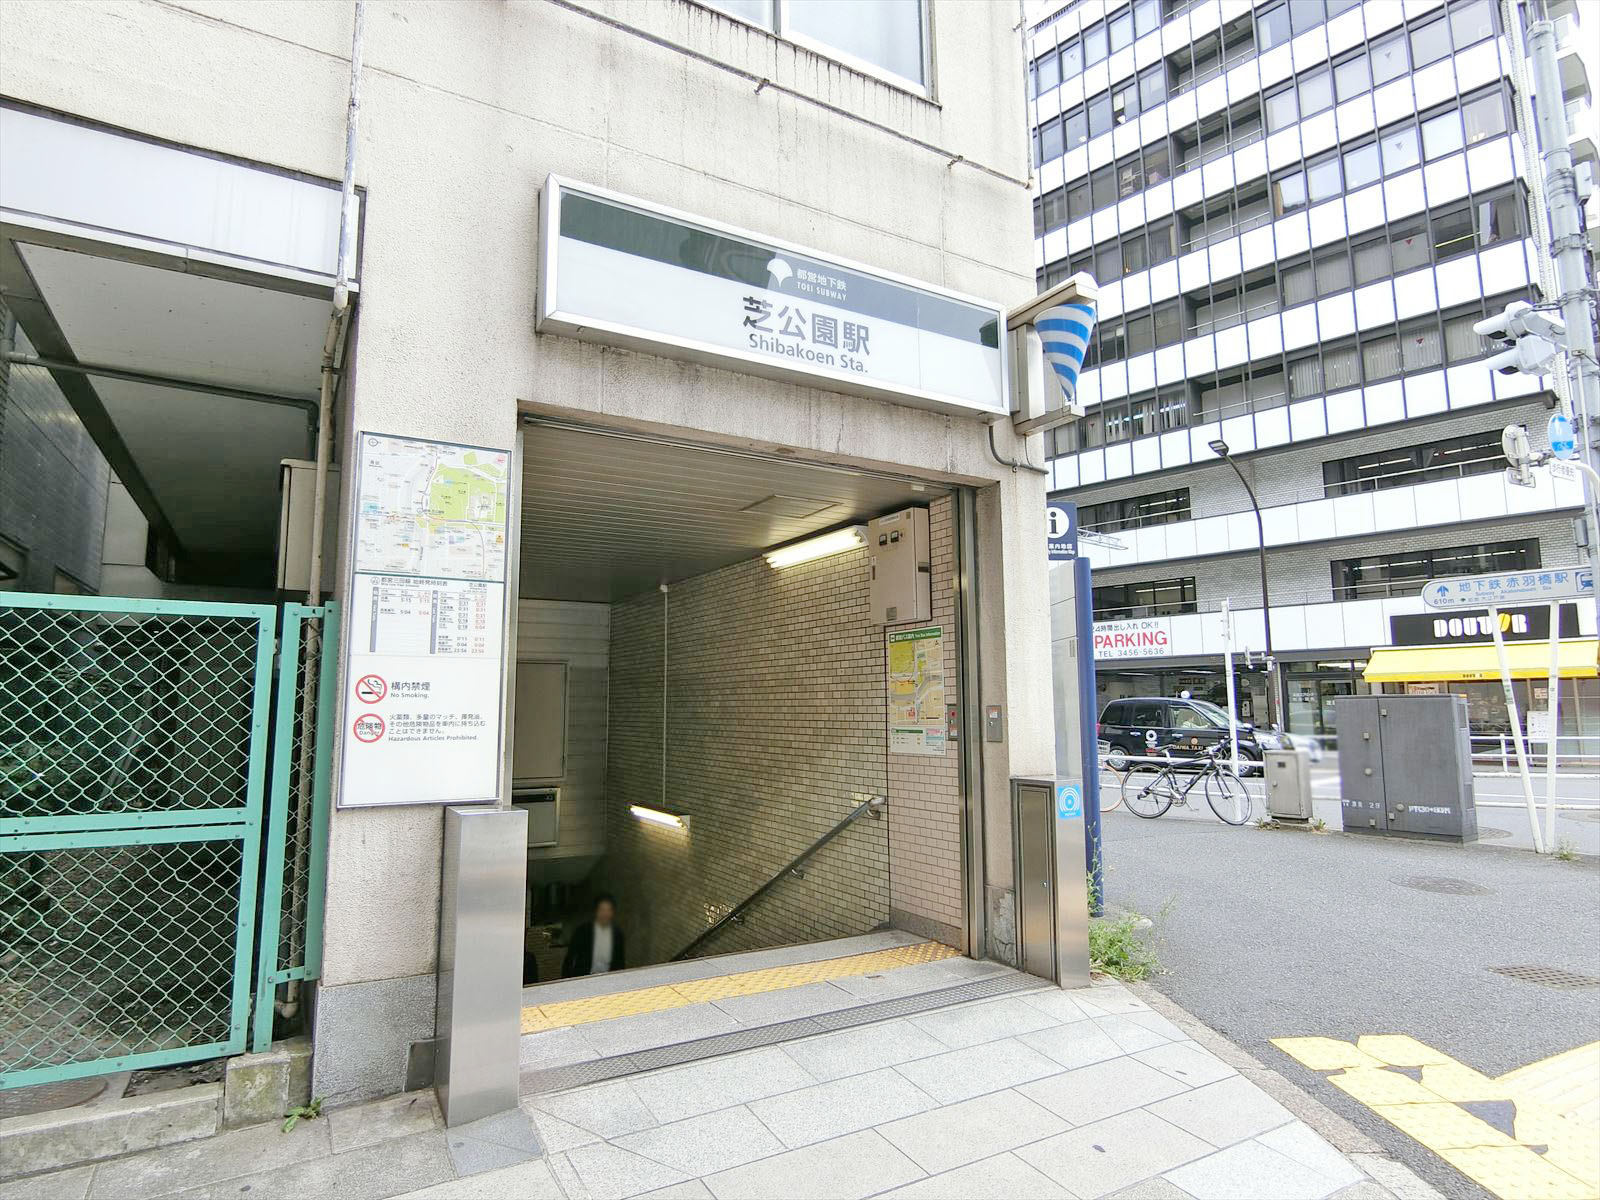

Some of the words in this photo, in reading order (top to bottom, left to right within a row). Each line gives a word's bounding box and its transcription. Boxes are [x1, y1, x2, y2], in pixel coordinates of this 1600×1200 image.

[797, 268, 847, 294] 都営地下鉄
[797, 281, 814, 295] TOEI
[816, 287, 847, 303] SUBWAY
[743, 296, 870, 357] 芝公園駅
[749, 333, 834, 366] Shibakoen
[840, 355, 868, 373] Sta.
[1458, 571, 1569, 593] 地下鉄赤羽橋駅
[1094, 630, 1168, 649] PARKING
[1118, 647, 1165, 657] 3456-5636
[391, 682, 431, 691] 構内禁煙
[357, 722, 382, 730] 危険物
